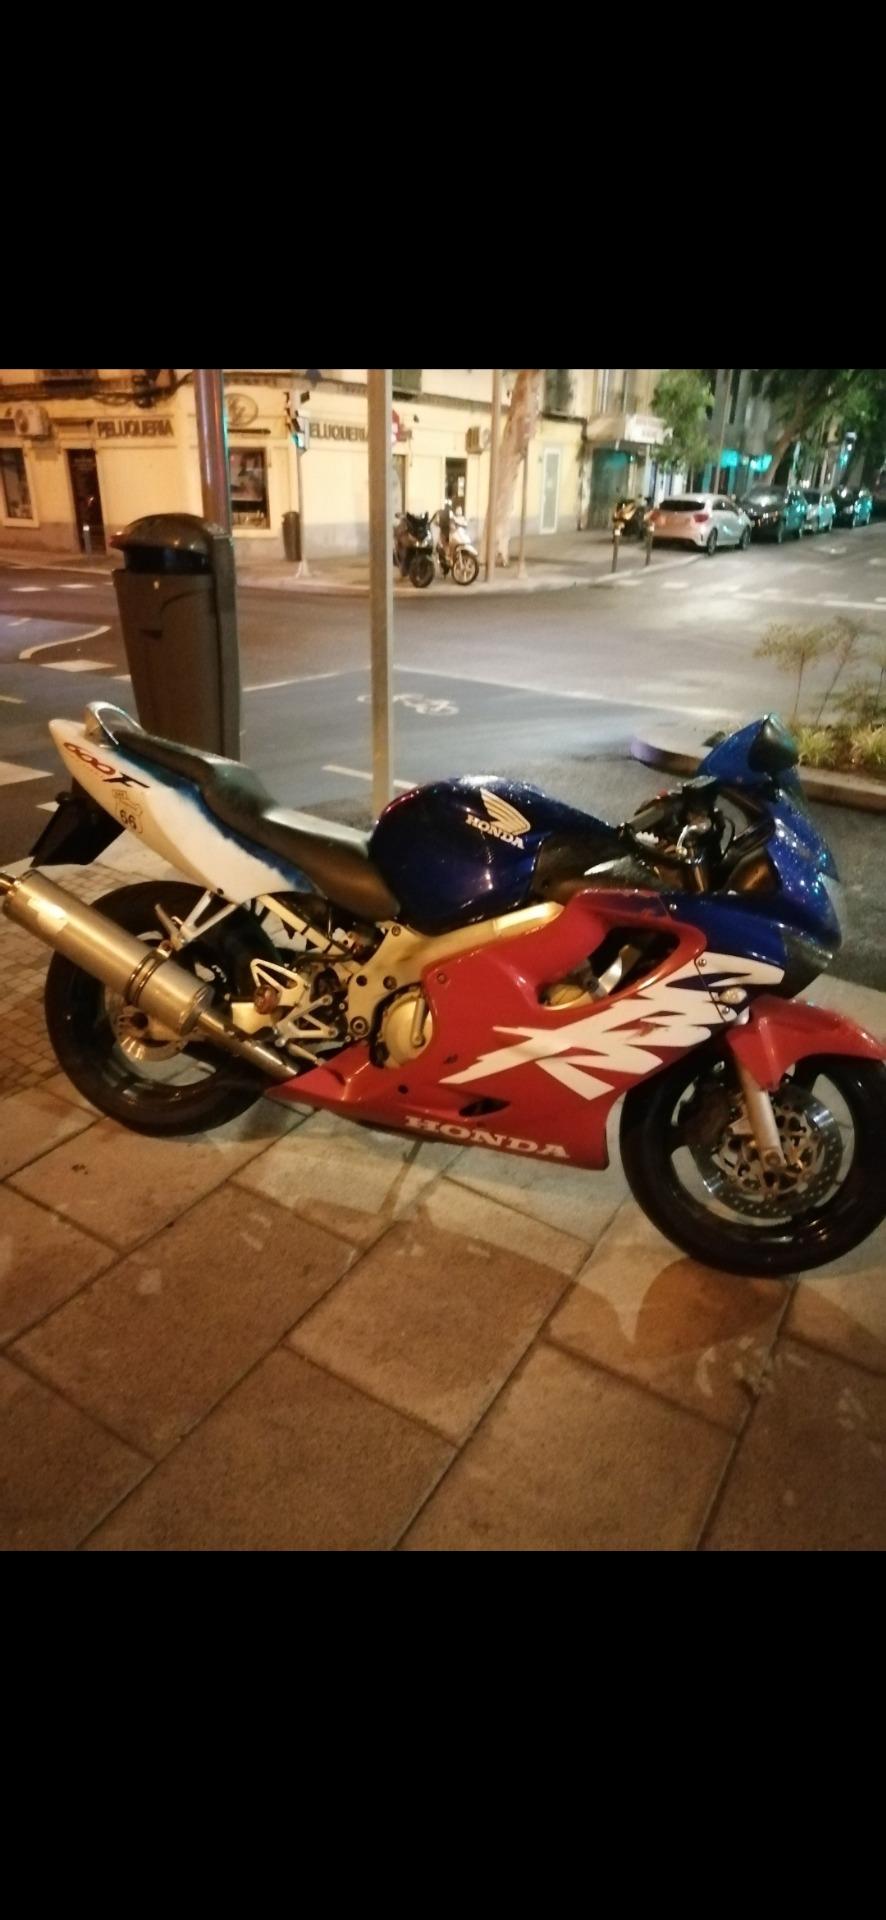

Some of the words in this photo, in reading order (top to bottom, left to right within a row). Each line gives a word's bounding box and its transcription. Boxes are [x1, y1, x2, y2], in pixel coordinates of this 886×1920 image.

[119, 809, 138, 830] 66
[465, 813, 524, 850] HONDA
[404, 1115, 570, 1159] HONDA
